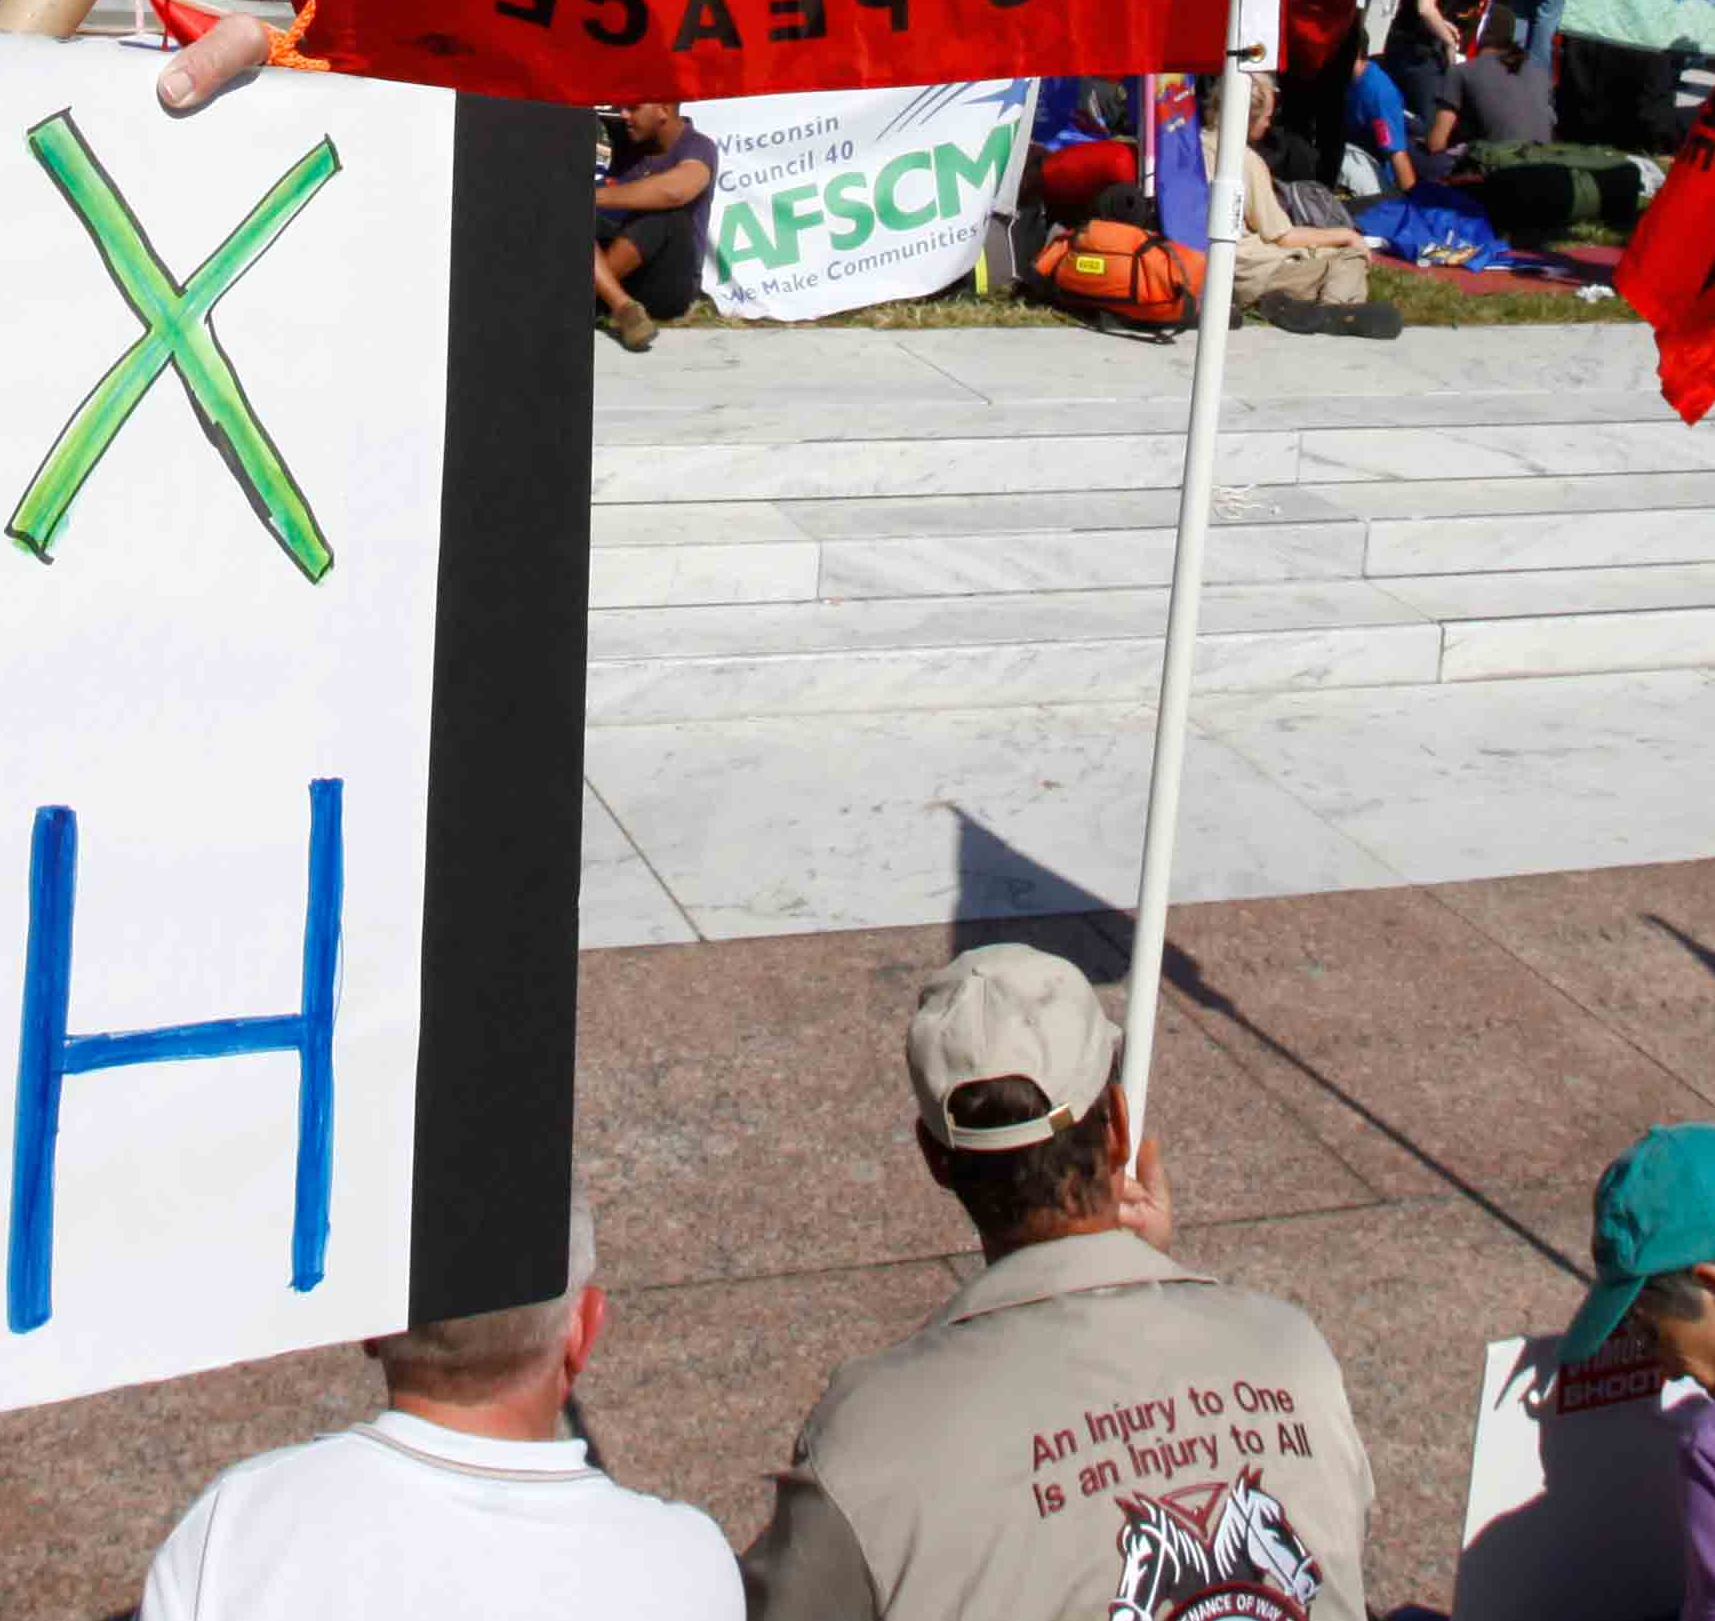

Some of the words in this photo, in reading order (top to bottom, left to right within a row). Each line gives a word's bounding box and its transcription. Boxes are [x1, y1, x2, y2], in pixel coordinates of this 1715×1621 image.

[715, 118, 1021, 286] AFSCM
[718, 151, 815, 193] Council
[825, 140, 854, 165] 40
[721, 284, 758, 305] We
[761, 273, 819, 296] Make
[827, 226, 979, 282] Communities
[1032, 1427, 1077, 1472] An
[1084, 1395, 1176, 1444] Injury
[1187, 1386, 1225, 1417] to
[1233, 1380, 1295, 1414] One
[1032, 1482, 1067, 1519] Is
[1078, 1459, 1120, 1498] an
[1127, 1433, 1219, 1481] Injury
[1230, 1423, 1266, 1456] to
[1277, 1421, 1314, 1458] All
[1236, 1592, 1255, 1612] OF
[1255, 1596, 1283, 1621] WAY
